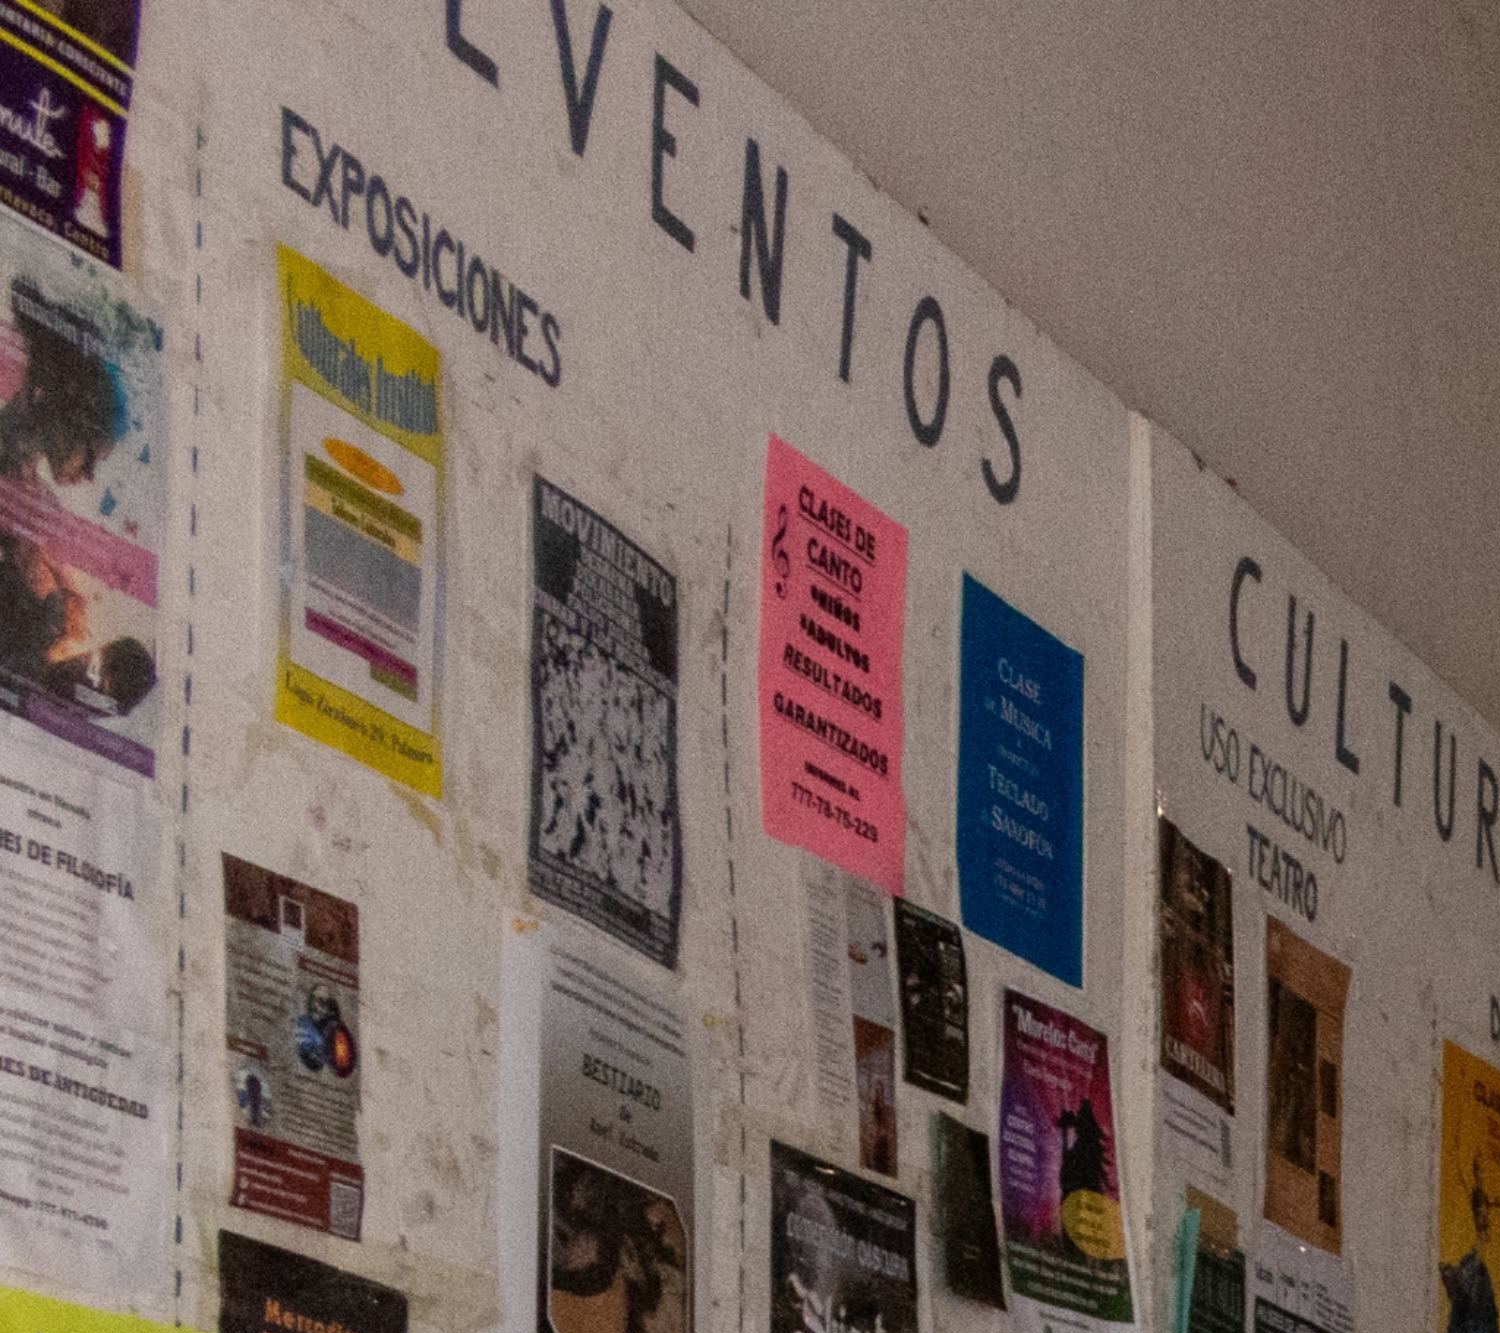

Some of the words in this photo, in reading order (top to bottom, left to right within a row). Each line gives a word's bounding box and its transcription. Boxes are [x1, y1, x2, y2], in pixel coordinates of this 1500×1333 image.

[281, 106, 563, 388] EXPOSICIONES
[798, 484, 851, 544] CLASES
[855, 525, 876, 561] DE
[807, 537, 862, 595] CANTO
[784, 643, 882, 720] RESULTADOS
[773, 691, 889, 775] GARANTIZADOS
[1201, 702, 1240, 785] USO
[1249, 744, 1347, 864] EXCLUSIVO
[1247, 824, 1318, 923] TEATRO
